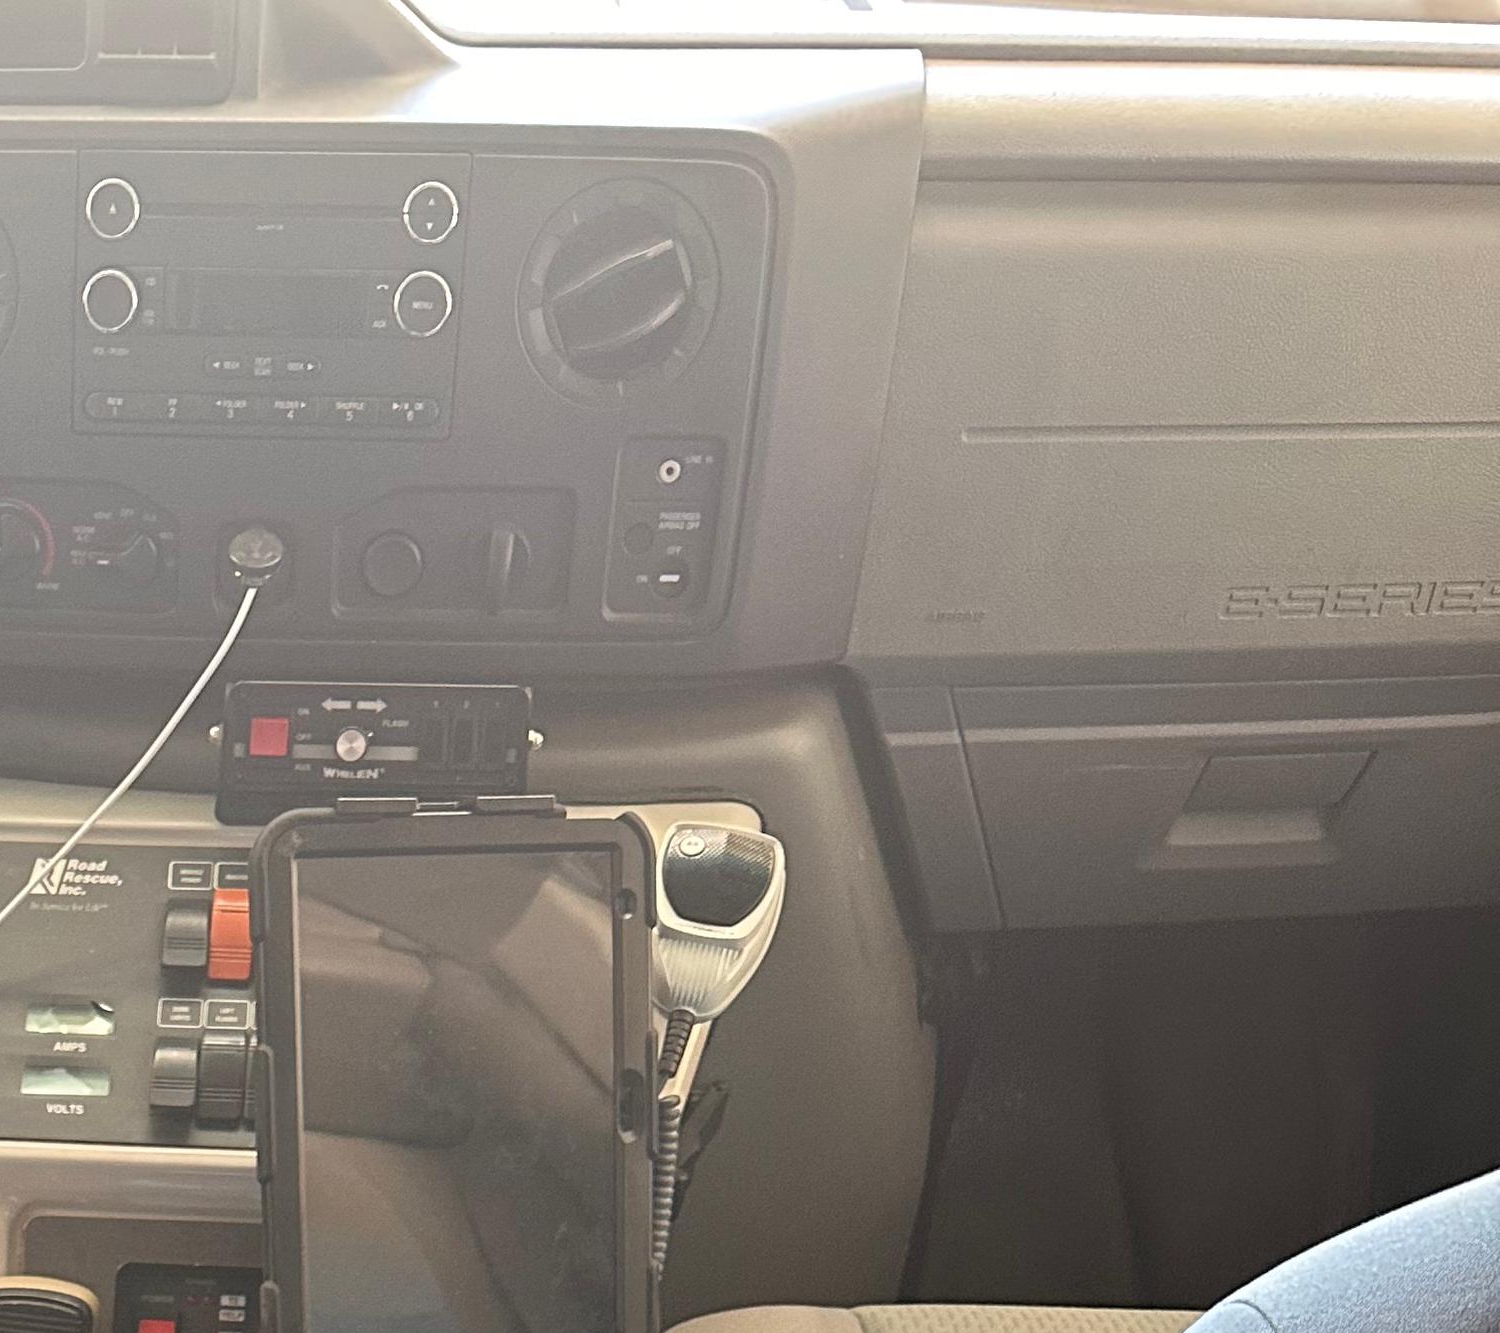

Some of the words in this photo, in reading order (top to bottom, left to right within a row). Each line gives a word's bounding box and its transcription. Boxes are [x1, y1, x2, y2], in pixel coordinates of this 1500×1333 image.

[67, 859, 107, 872] Road
[62, 872, 124, 887] Rescue,
[58, 885, 87, 896] Inc.
[52, 1041, 88, 1053] AMPS
[45, 1102, 85, 1115] VOLTS
